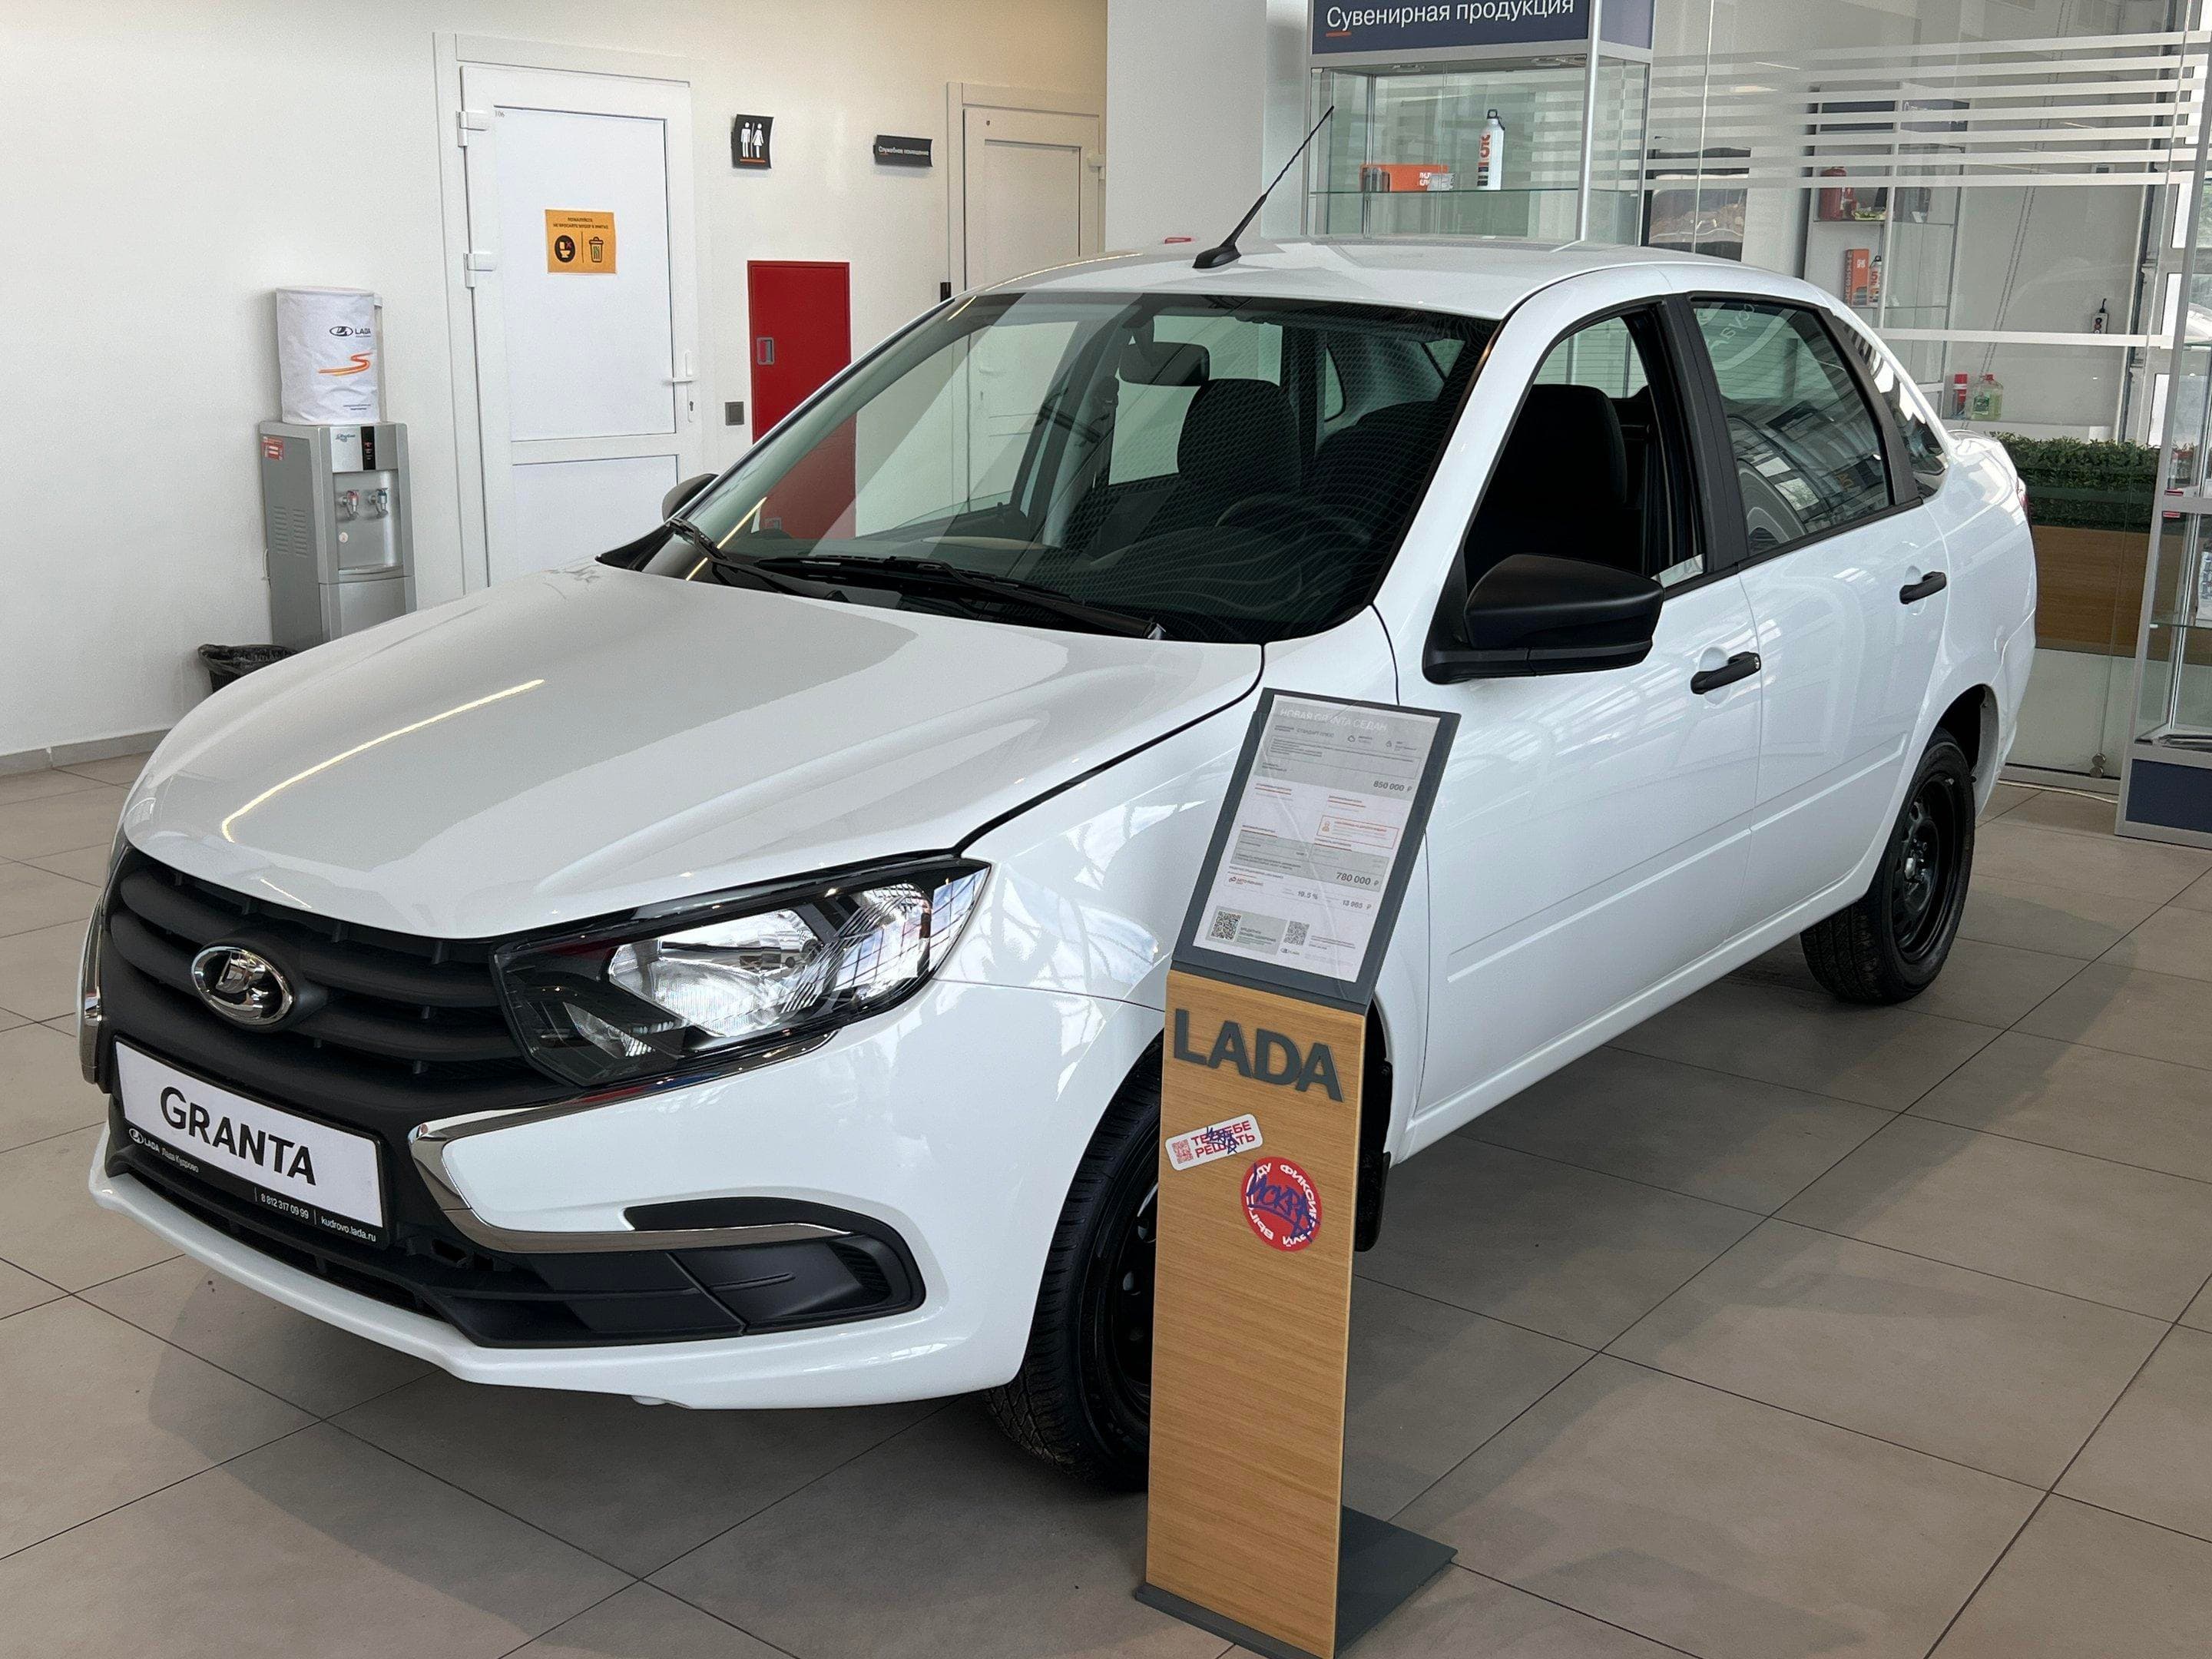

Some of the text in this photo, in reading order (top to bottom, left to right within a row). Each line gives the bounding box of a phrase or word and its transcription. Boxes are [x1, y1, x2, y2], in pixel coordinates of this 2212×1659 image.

[1326, 0, 1574, 31] Сувенирная продукция
[1353, 718, 1388, 731] СЕДАН
[1373, 780, 1388, 789] 850
[1389, 783, 1404, 792] 000
[1336, 872, 1353, 882] 780
[1354, 875, 1371, 885] 000
[1174, 1008, 1344, 1103] LADA
[144, 1137, 160, 1153] LADA
[161, 1086, 316, 1186] GRANTA
[261, 1193, 310, 1219] 8 812 317 09 99
[321, 1216, 376, 1243] kudrovo.lada.ru
